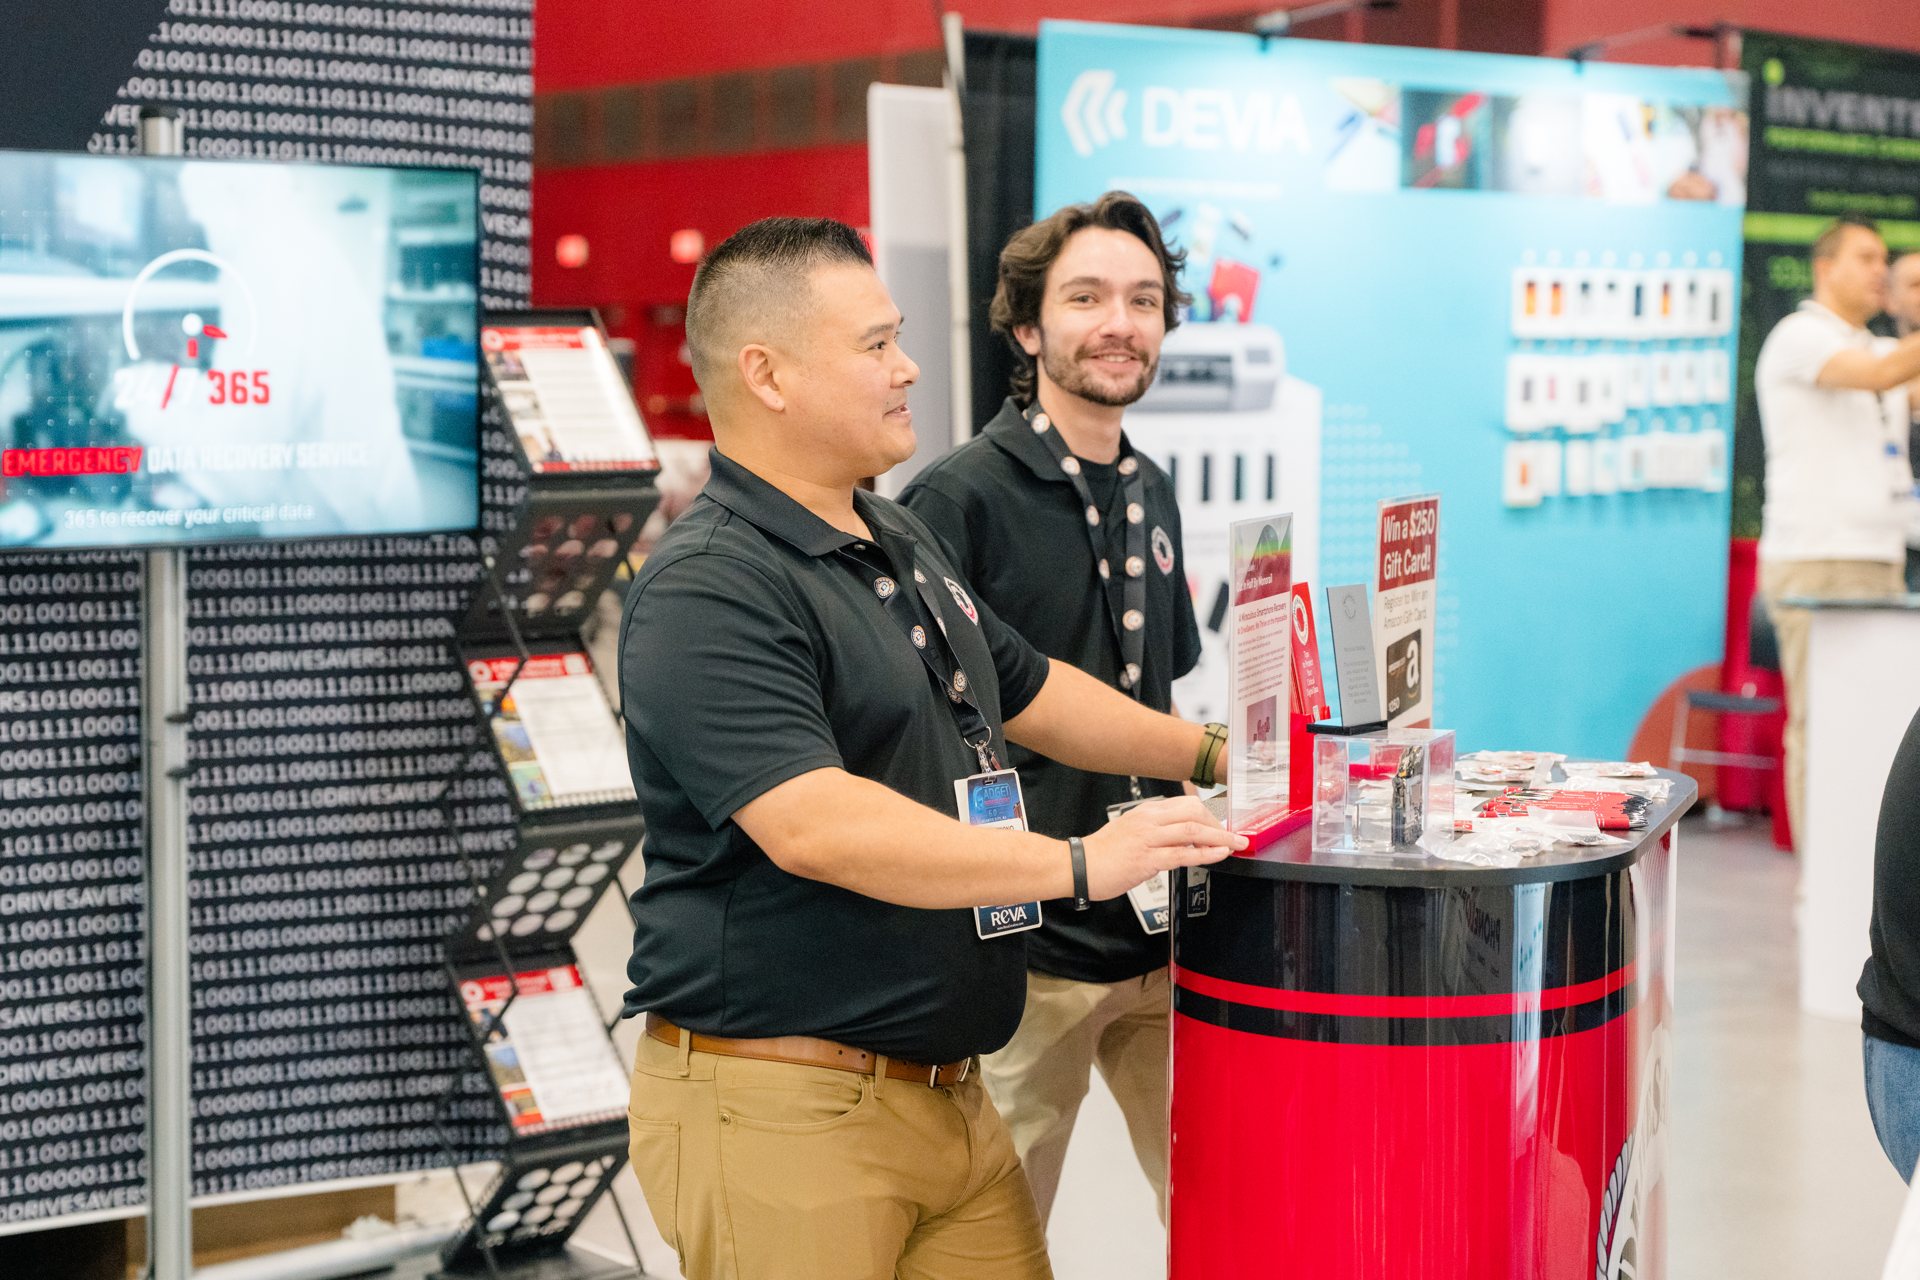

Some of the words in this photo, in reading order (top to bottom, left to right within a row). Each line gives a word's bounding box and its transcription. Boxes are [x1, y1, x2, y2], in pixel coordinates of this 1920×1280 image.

[1142, 86, 1312, 152] DEVIA
[208, 371, 271, 405] 365
[2, 447, 143, 476] EMERGENCY
[147, 446, 198, 473] DATA
[201, 444, 293, 471] RECOVERY
[296, 442, 369, 468] SERVICE
[99, 509, 117, 527] to
[120, 507, 182, 527] recover
[184, 506, 219, 529] your
[222, 502, 275, 524] critical
[277, 501, 314, 522] data
[1383, 515, 1400, 543] Win
[1402, 519, 1409, 539] a
[1409, 507, 1435, 541] $250
[1383, 550, 1402, 580] Gift
[1403, 544, 1431, 576] Card!
[1406, 639, 1419, 689] a
